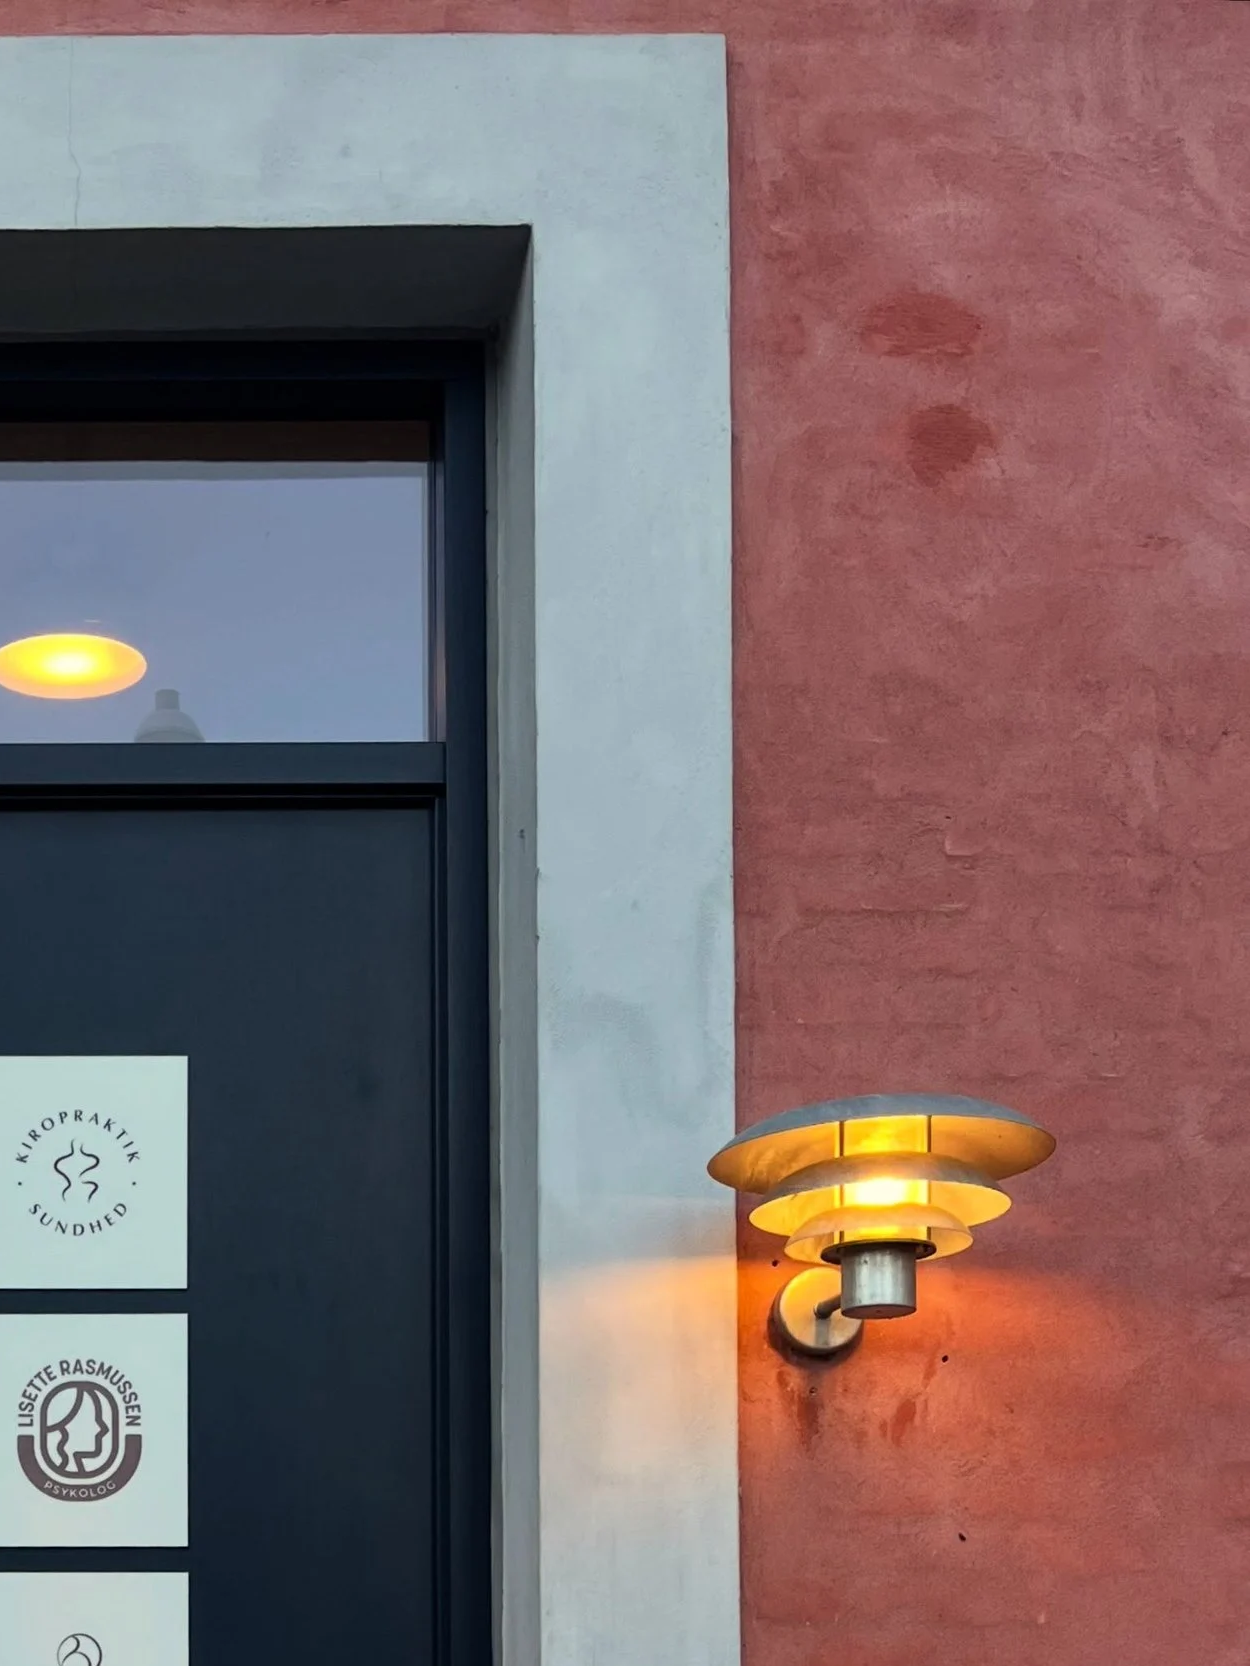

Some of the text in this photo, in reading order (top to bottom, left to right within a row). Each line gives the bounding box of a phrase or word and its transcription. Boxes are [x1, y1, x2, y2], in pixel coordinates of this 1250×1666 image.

[15, 1109, 140, 1163] KIROPRAKTIK
[29, 1203, 127, 1236] SUNDHED
[17, 1359, 141, 1427] LISETTE RASMUSSEN
[44, 1481, 116, 1498] PSYKOLOG
